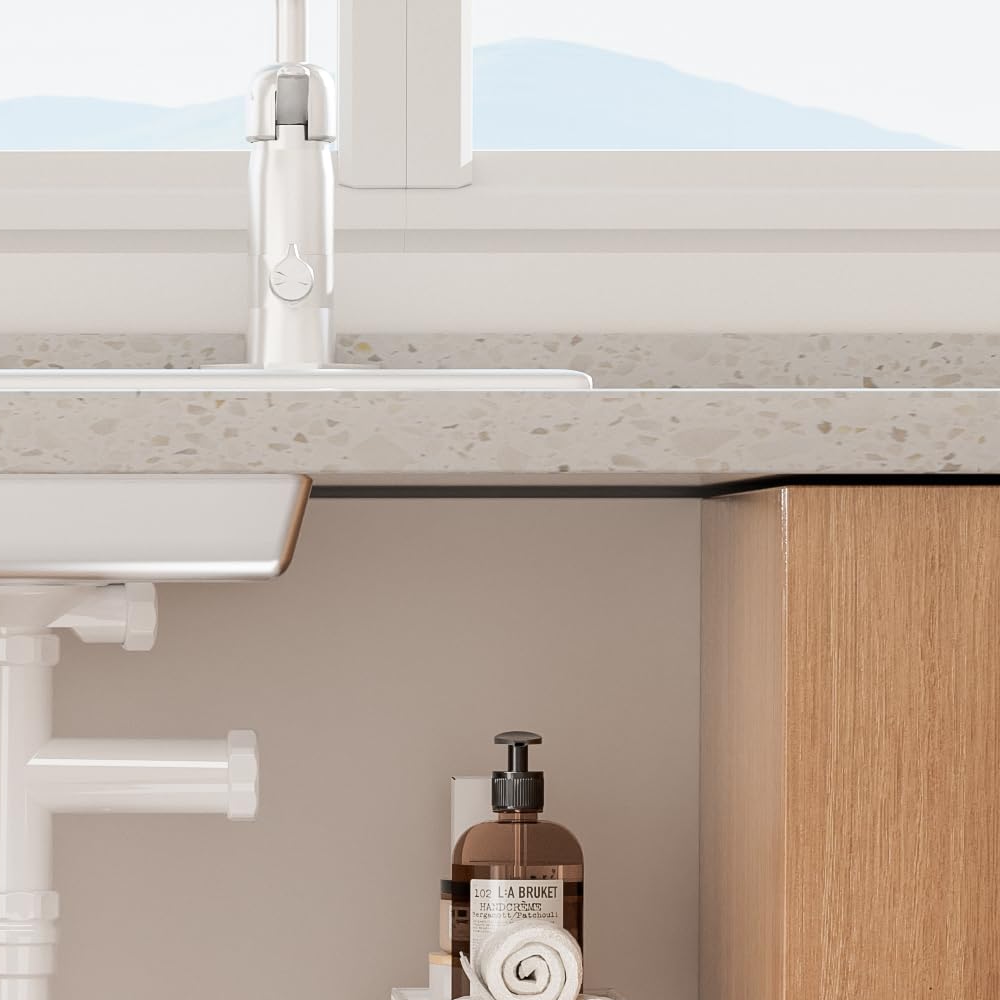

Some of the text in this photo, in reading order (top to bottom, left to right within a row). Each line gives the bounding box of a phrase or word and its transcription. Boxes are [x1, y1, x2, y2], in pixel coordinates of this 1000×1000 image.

[474, 886, 558, 898] 102 L:A BRUKET
